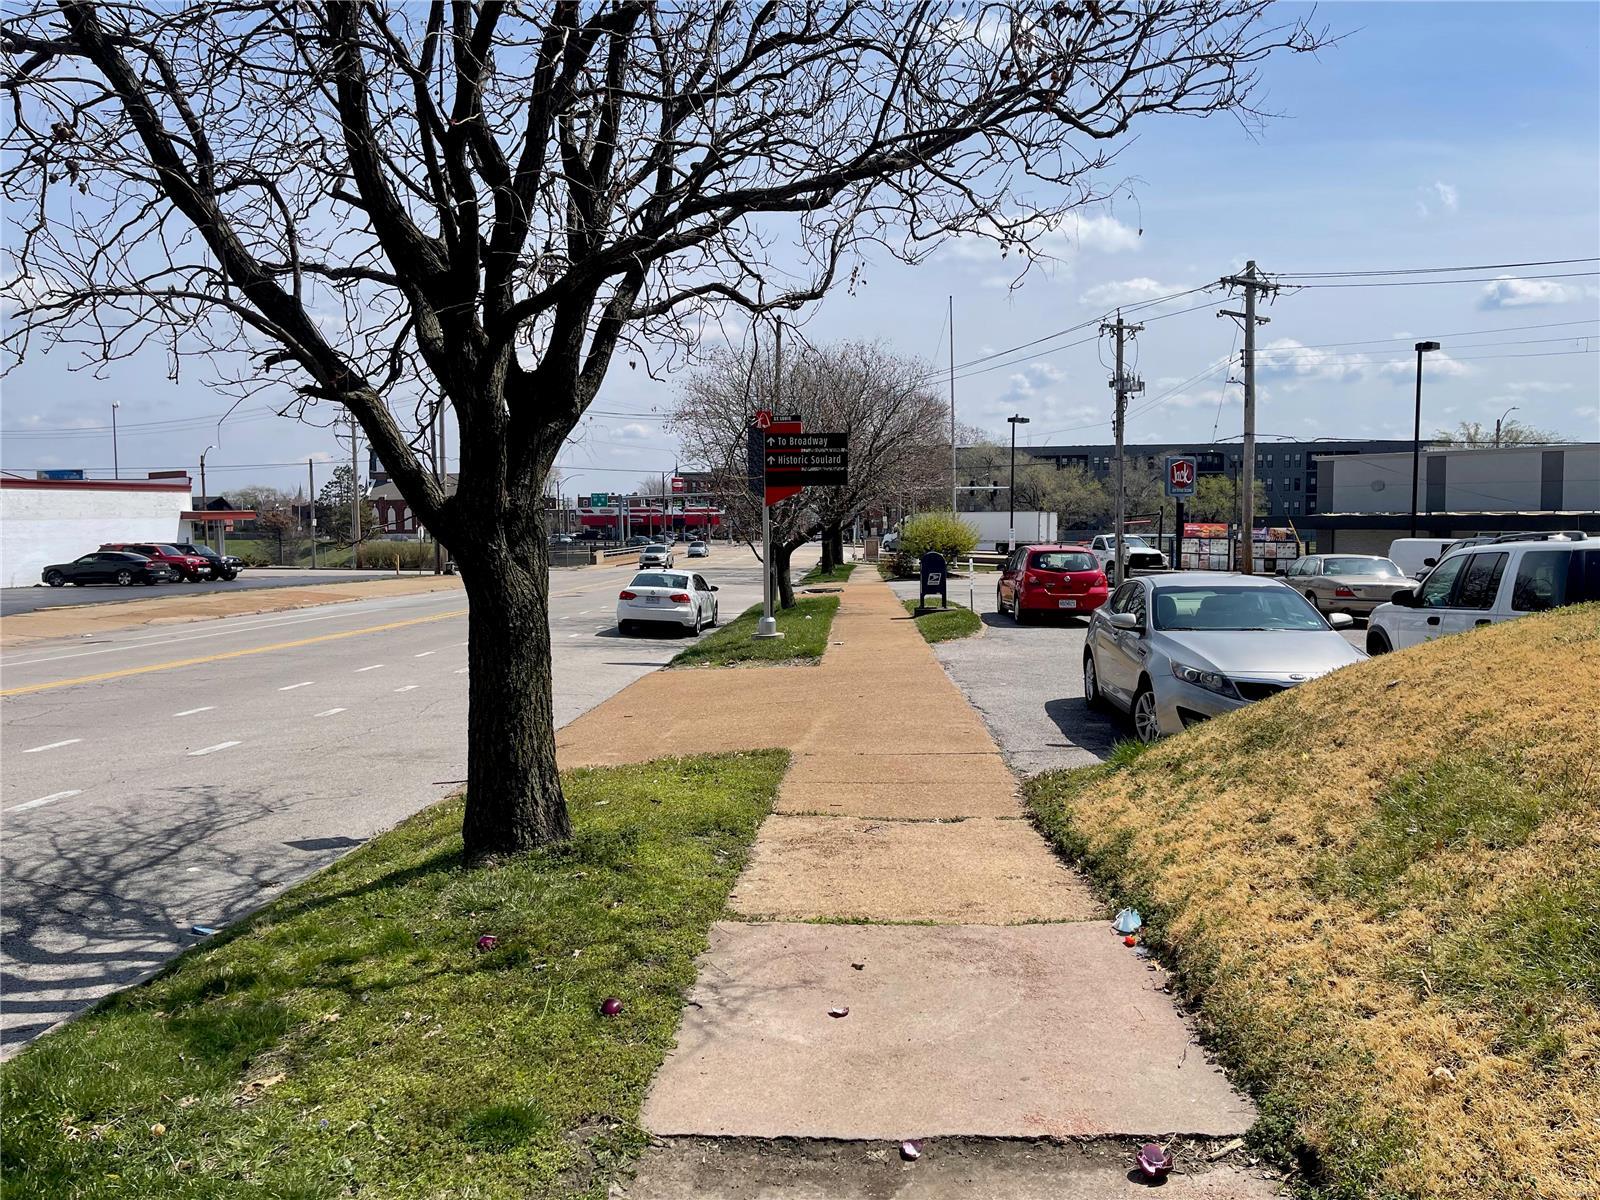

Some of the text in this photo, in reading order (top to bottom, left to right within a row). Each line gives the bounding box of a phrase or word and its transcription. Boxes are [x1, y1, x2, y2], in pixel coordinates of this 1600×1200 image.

[778, 436, 828, 447] To Broadway
[778, 455, 841, 465] Historic Soulard
[1172, 463, 1193, 484] Jack
